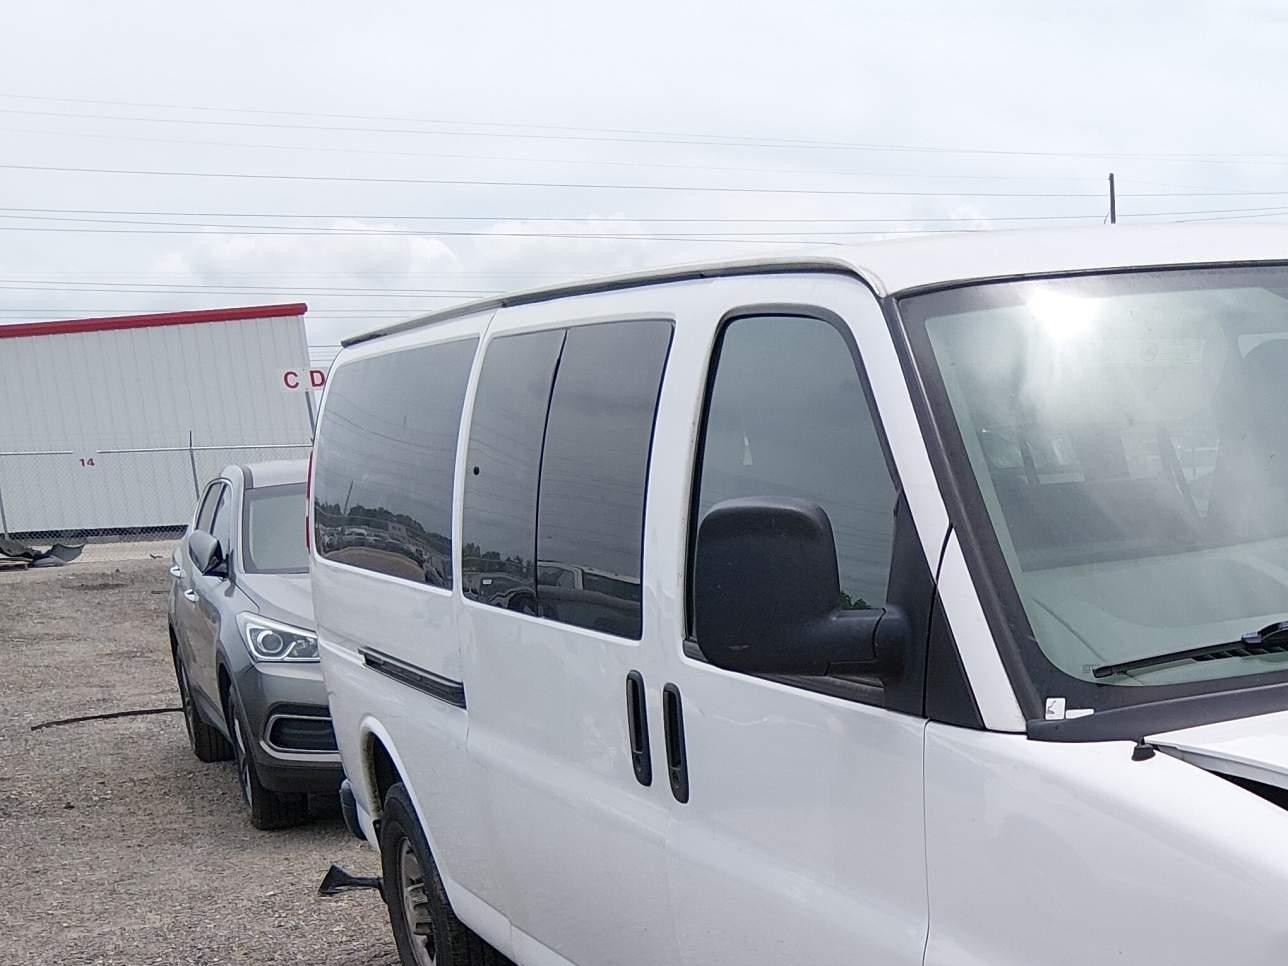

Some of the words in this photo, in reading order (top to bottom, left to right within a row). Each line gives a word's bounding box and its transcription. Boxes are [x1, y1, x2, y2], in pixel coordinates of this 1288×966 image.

[283, 370, 300, 389] C
[309, 369, 326, 387] D
[79, 457, 96, 468] 14
